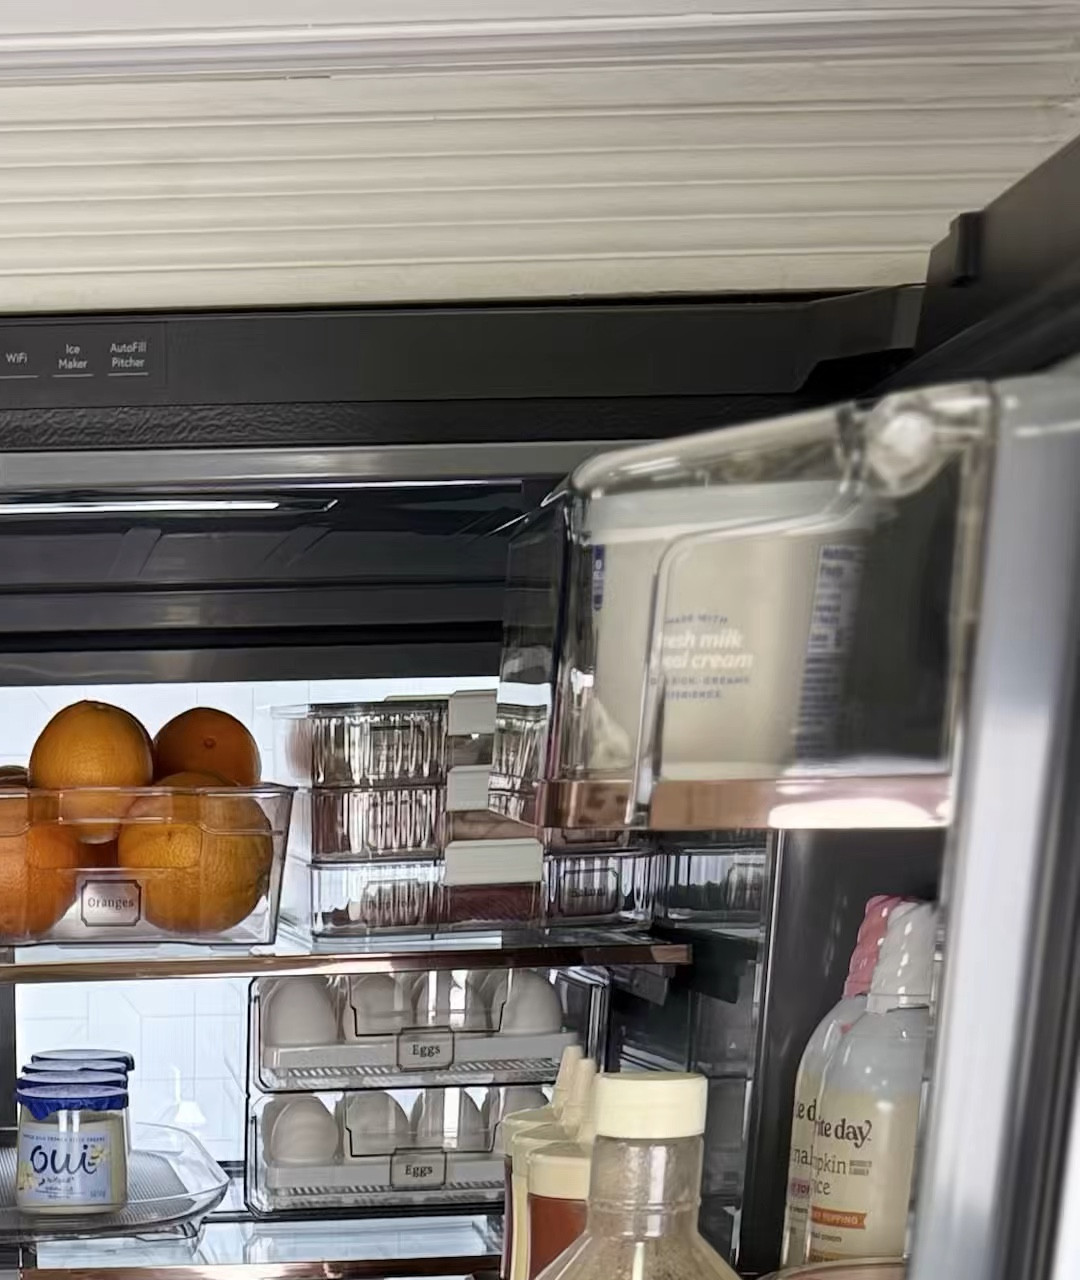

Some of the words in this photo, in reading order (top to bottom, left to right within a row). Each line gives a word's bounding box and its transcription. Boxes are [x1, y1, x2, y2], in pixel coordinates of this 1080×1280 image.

[65, 344, 80, 354] Ice
[110, 341, 147, 353] AutoFill
[5, 352, 28, 363] WiFi
[111, 357, 145, 368] Pitcher
[58, 359, 88, 369] Maker
[87, 897, 135, 911] Oranges
[412, 1043, 441, 1058] Eggs
[405, 1164, 433, 1178] Eggs
